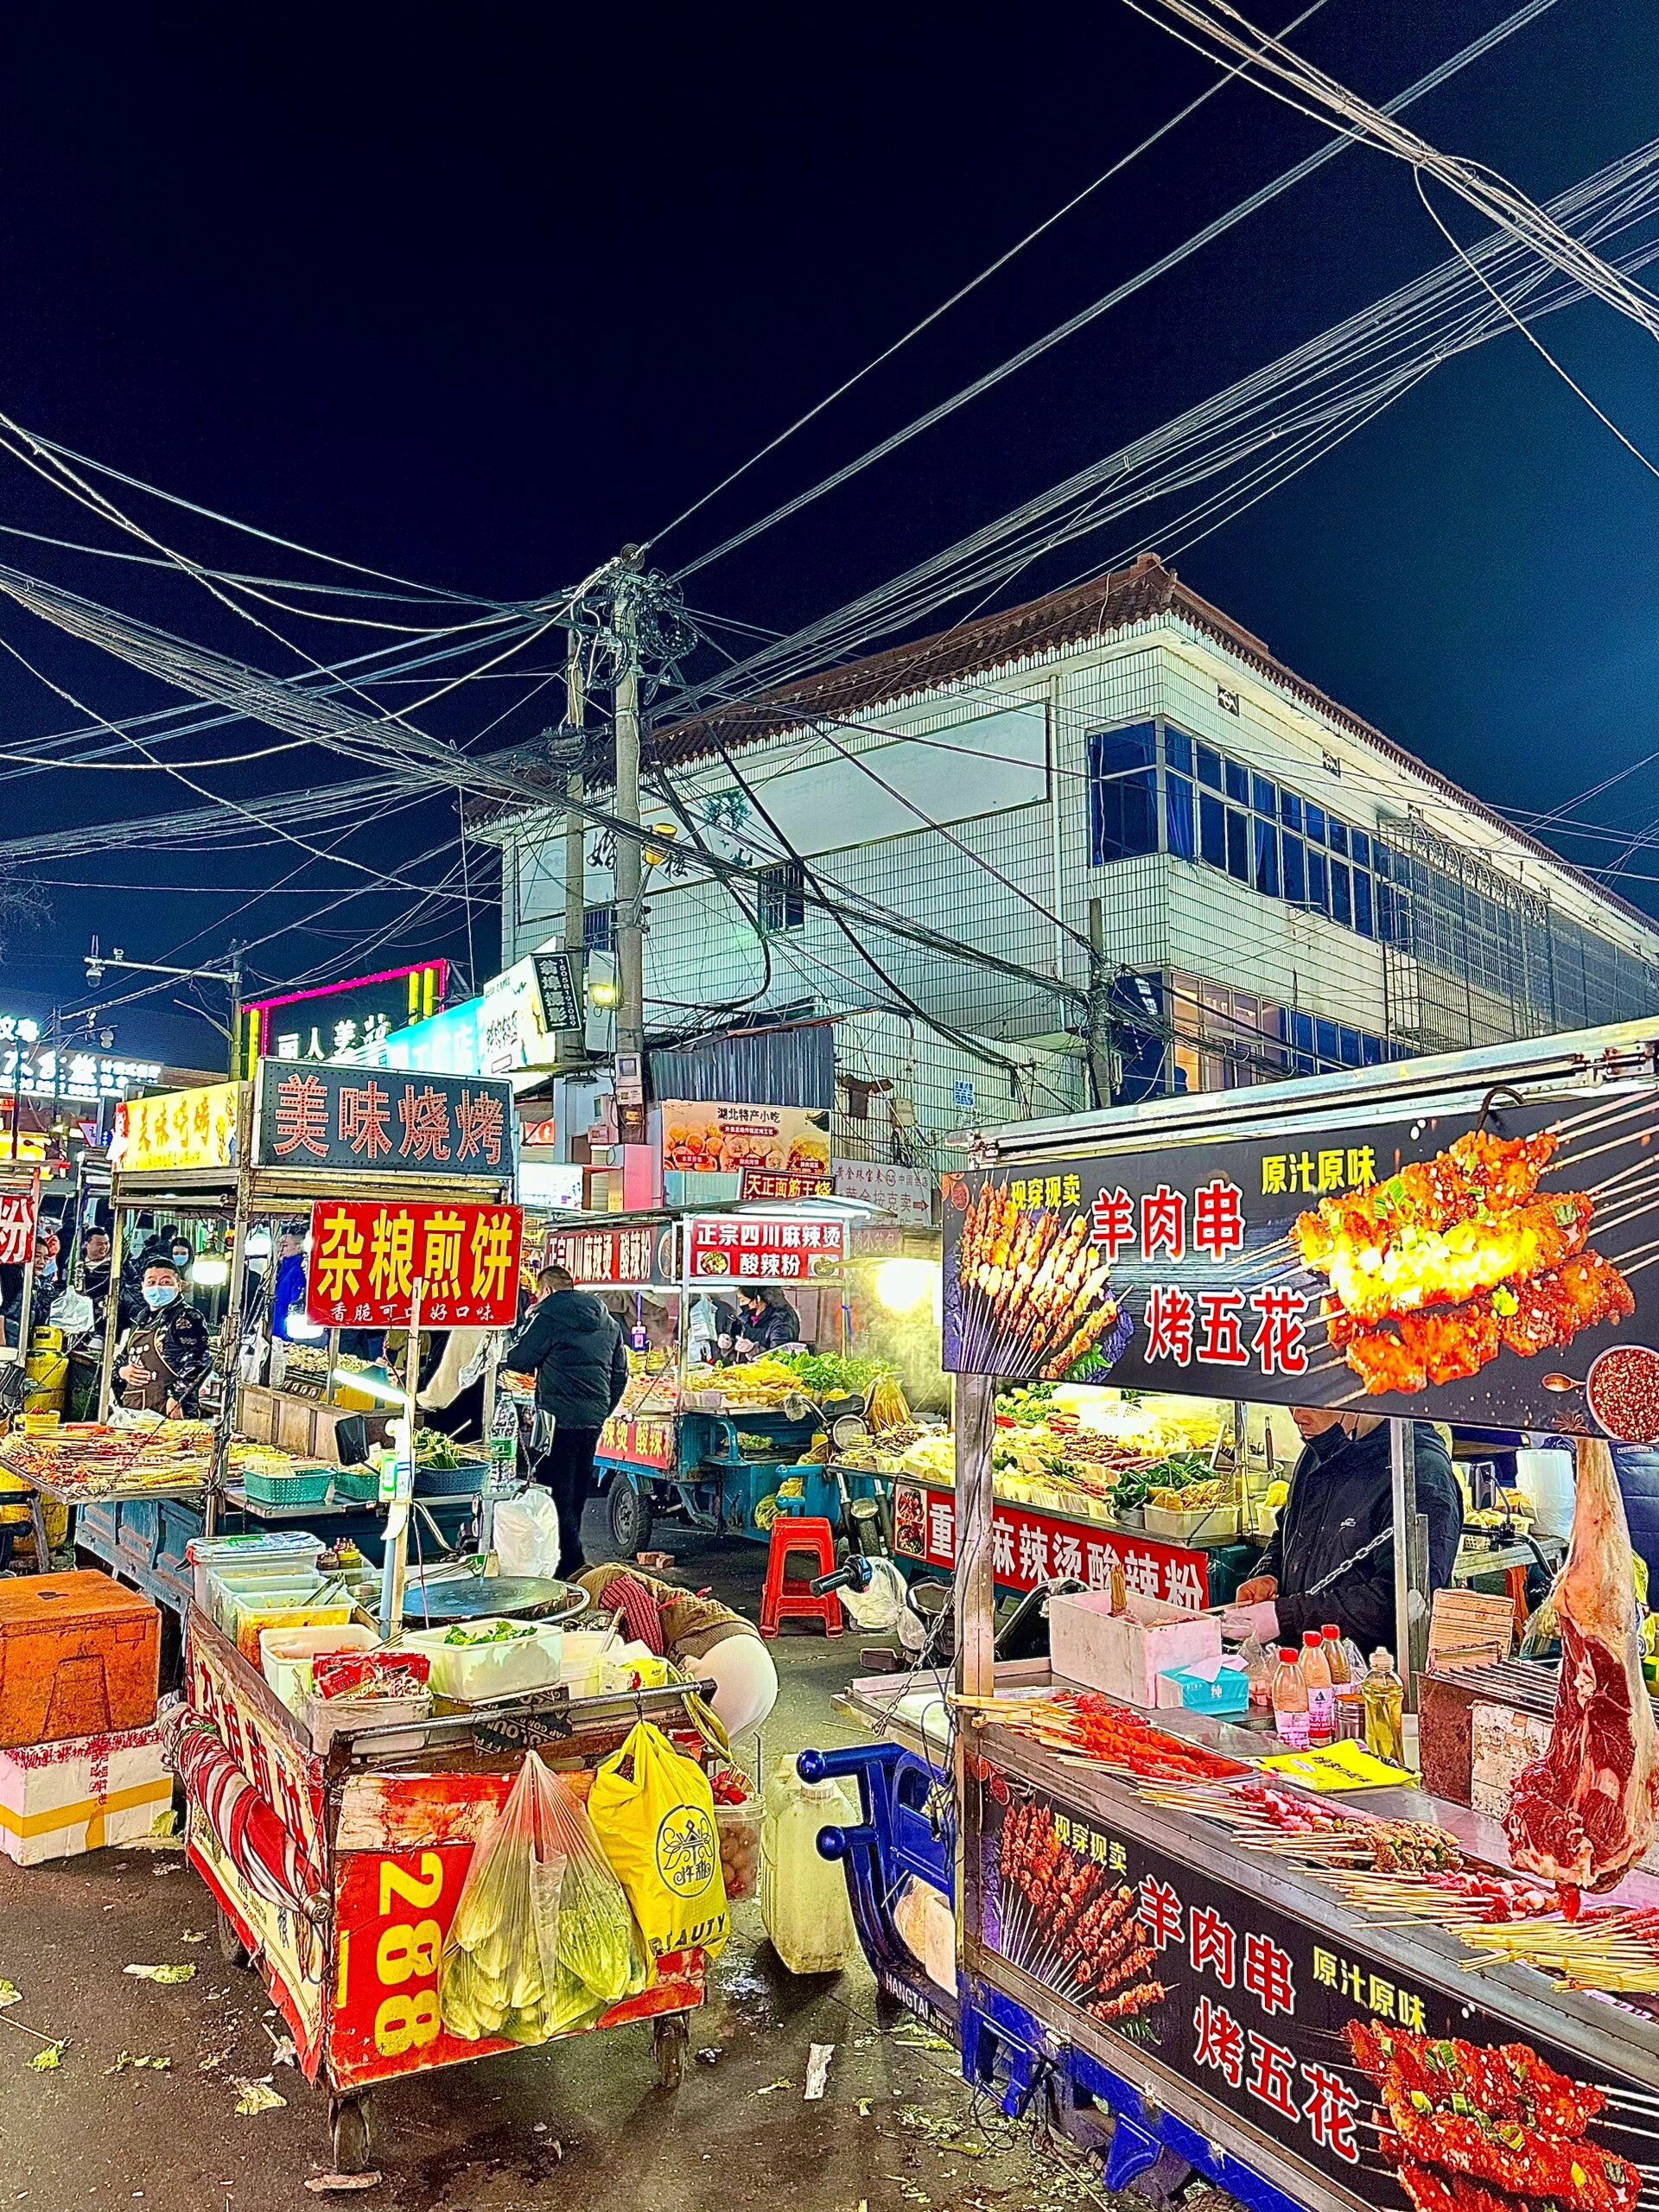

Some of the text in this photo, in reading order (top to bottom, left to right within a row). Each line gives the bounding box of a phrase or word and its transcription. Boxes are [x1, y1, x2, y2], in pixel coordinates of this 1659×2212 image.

[272, 1072, 504, 1166] 美味烧烤
[717, 1107, 780, 1123] 湖北特产小吃
[1010, 1173, 1082, 1211] 现穿现卖
[1261, 1146, 1376, 1196] 原汁原味
[316, 1206, 512, 1301] 杂粮煎饼
[549, 1230, 652, 1281] 正宗四川麻辣烫 酸辣粉
[696, 1224, 841, 1249] 正宗四川麻辣烫
[1091, 1179, 1246, 1264] 羊肉串
[740, 1252, 801, 1276] 酸辣粉
[330, 1302, 494, 1323] 香脆可口好口味
[1144, 1285, 1310, 1376] 烤五花
[930, 1503, 1204, 1611] 重麻辣烫酸辣粉
[1053, 1812, 1128, 1877] 现穿现卖
[374, 1851, 443, 2057] 288
[1138, 1873, 1297, 2016] 羊肉串
[886, 1971, 929, 2021] HANGTAI
[1313, 1945, 1427, 2036] 原汁原味
[1193, 1994, 1361, 2165] 烤五花
